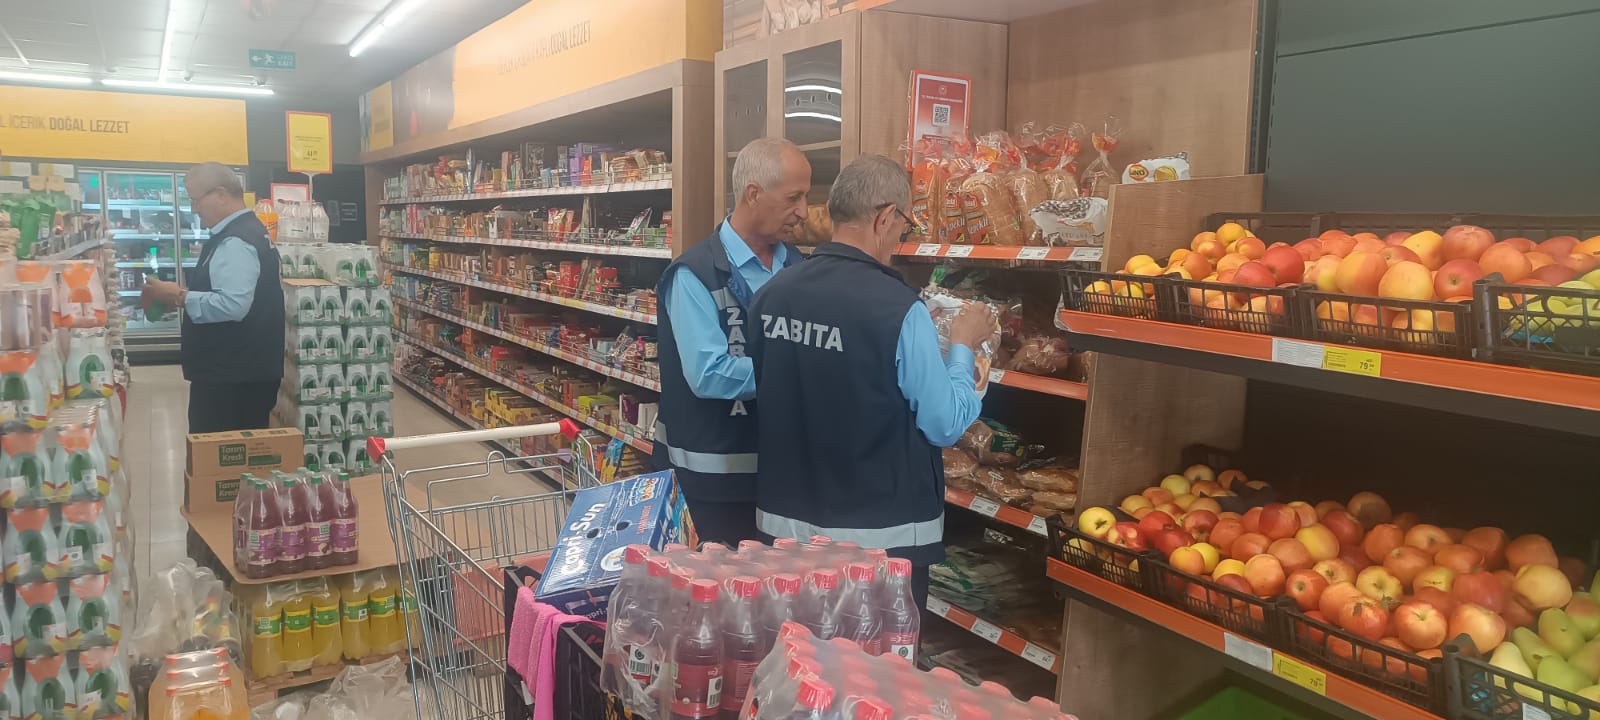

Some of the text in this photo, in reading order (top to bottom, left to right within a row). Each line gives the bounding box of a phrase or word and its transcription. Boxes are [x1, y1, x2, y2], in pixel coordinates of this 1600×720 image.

[569, 20, 591, 48] LEZZET
[49, 115, 87, 132] DOĞAL
[90, 119, 129, 134] LEZZET
[761, 314, 844, 352] ZABITA
